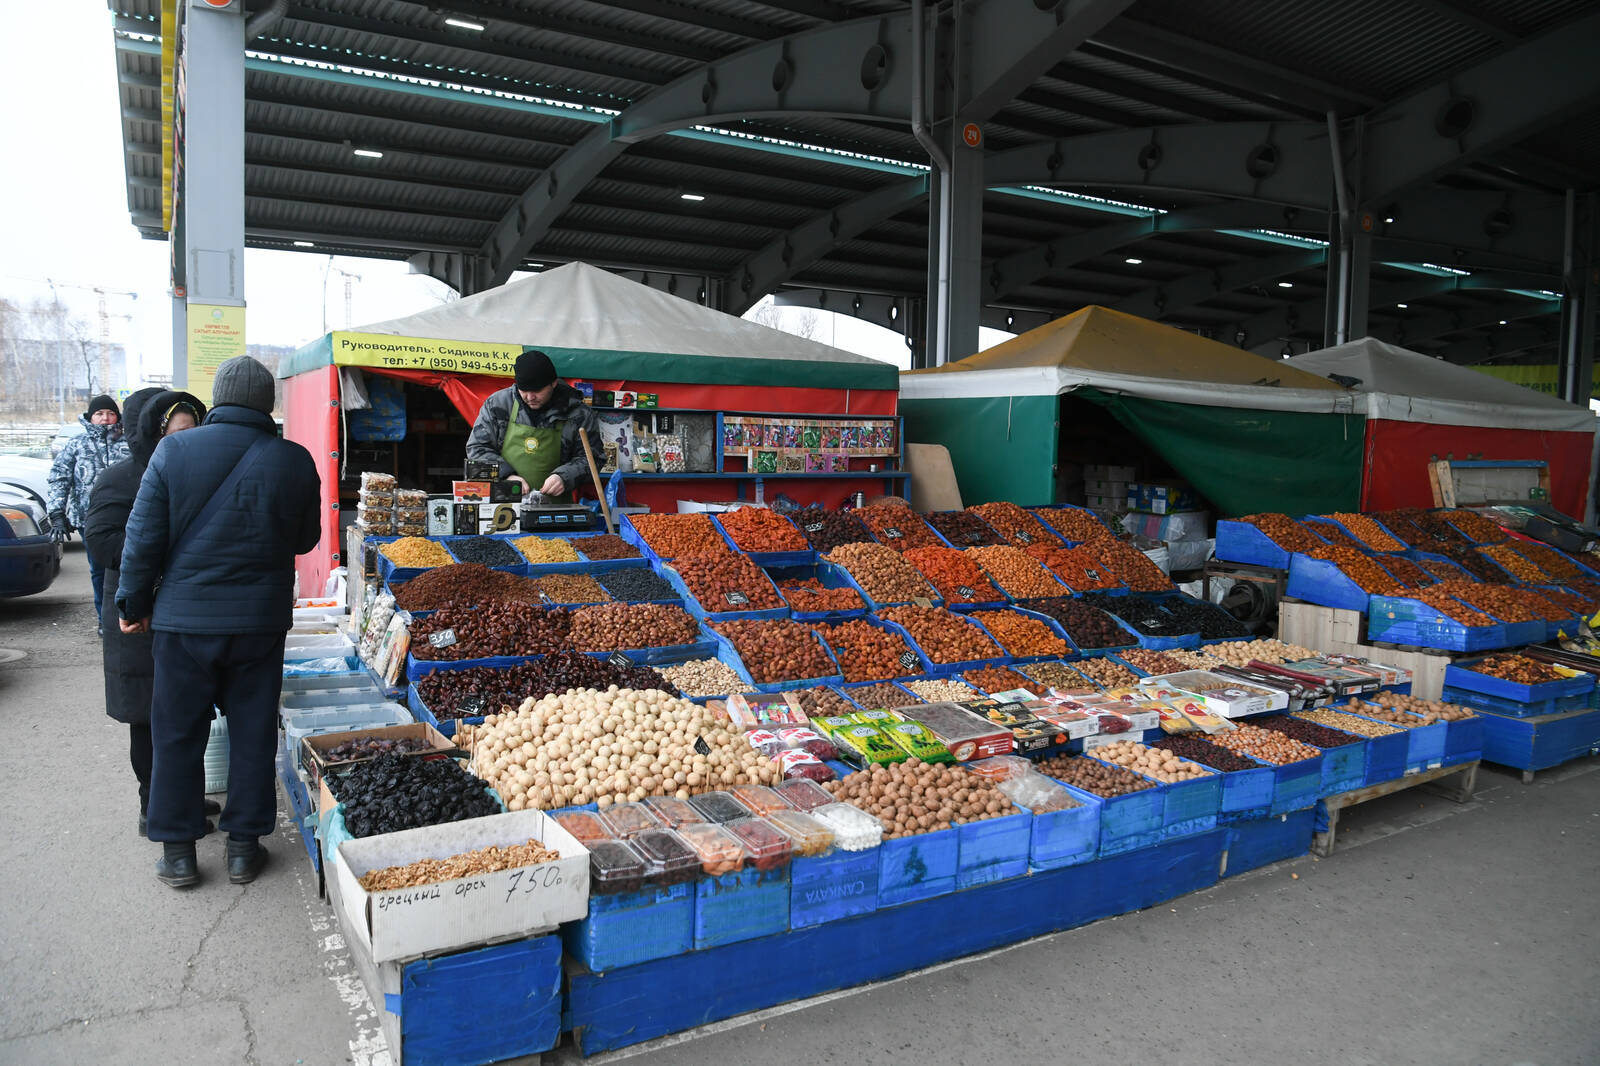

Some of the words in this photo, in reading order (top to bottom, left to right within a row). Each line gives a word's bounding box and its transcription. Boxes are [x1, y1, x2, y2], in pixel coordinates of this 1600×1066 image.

[341, 339, 436, 354] Руководитель:
[438, 346, 490, 359] Сидиков
[492, 351, 514, 361] К.К.
[383, 356, 409, 366] тел:
[411, 357, 426, 367] +7
[429, 357, 458, 371] (950)
[460, 359, 515, 372] 949-45-97
[430, 631, 453, 643] 350
